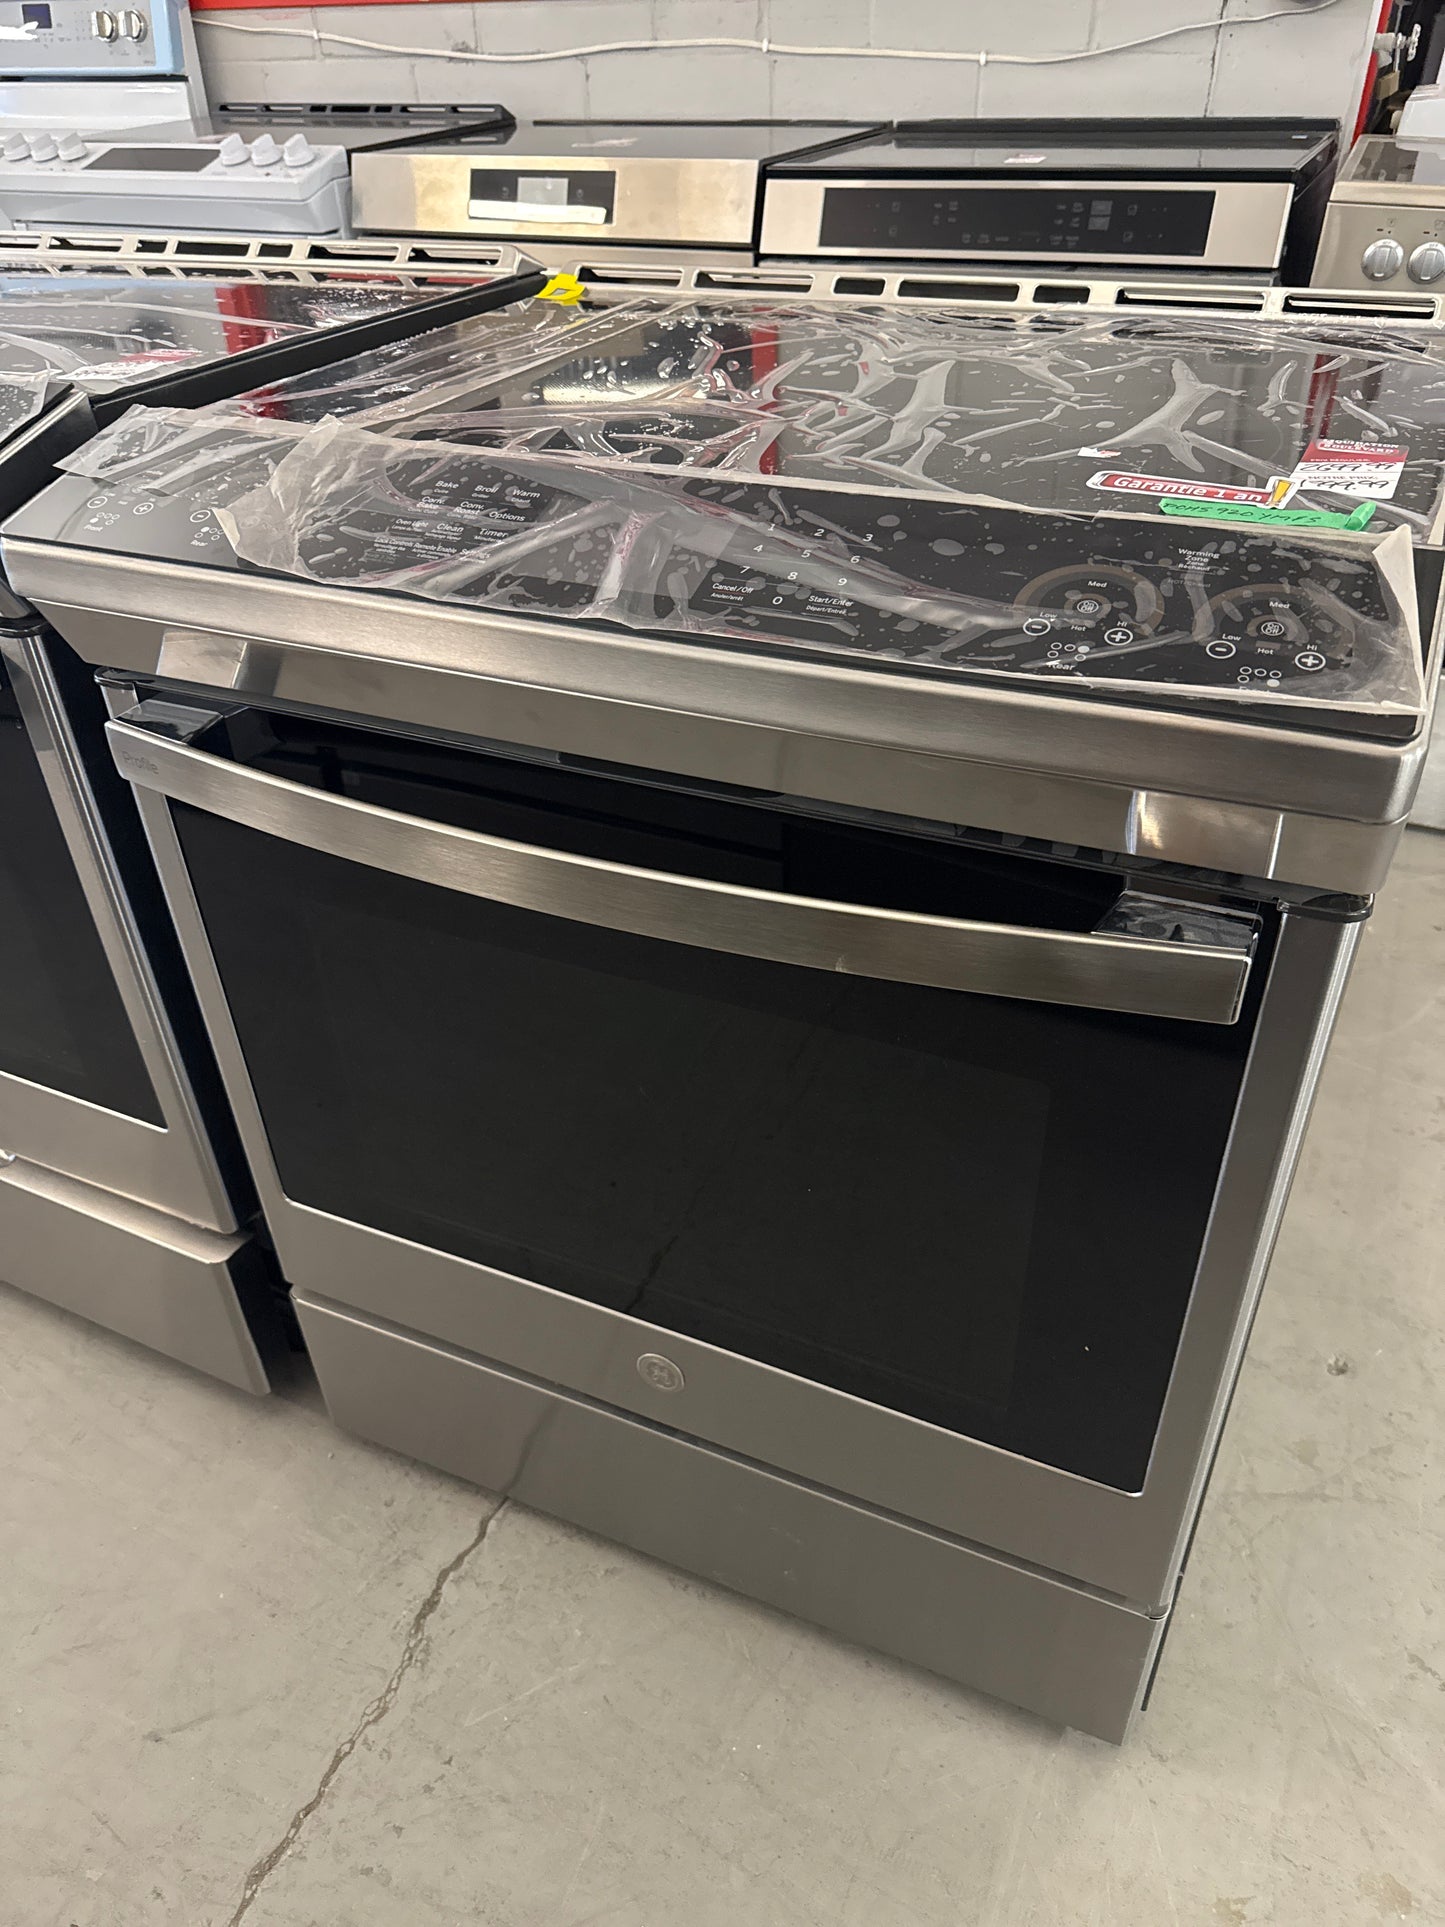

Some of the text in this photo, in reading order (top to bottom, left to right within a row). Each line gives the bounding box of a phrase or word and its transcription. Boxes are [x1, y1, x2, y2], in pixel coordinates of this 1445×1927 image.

[435, 480, 459, 490] Bake
[474, 485, 499, 494] Broil
[1114, 477, 1262, 502] Garantie 1 an
[512, 488, 541, 499] Warm
[488, 511, 526, 523] Options
[436, 523, 464, 533] Clean
[767, 523, 775, 531] 1
[479, 528, 508, 538] Timer
[814, 528, 824, 537] 2
[863, 533, 873, 542] 3
[753, 543, 763, 552] 4
[801, 549, 812, 558] 5
[1178, 548, 1220, 559] Warming
[850, 555, 860, 564] 6
[740, 565, 750, 574] 7
[787, 571, 798, 581] 8
[838, 577, 848, 587] 9
[1088, 580, 1108, 588] Med
[772, 596, 783, 605] 0
[808, 595, 854, 607] Start/Enter
[1269, 601, 1290, 609] Med
[1222, 633, 1242, 641] Low
